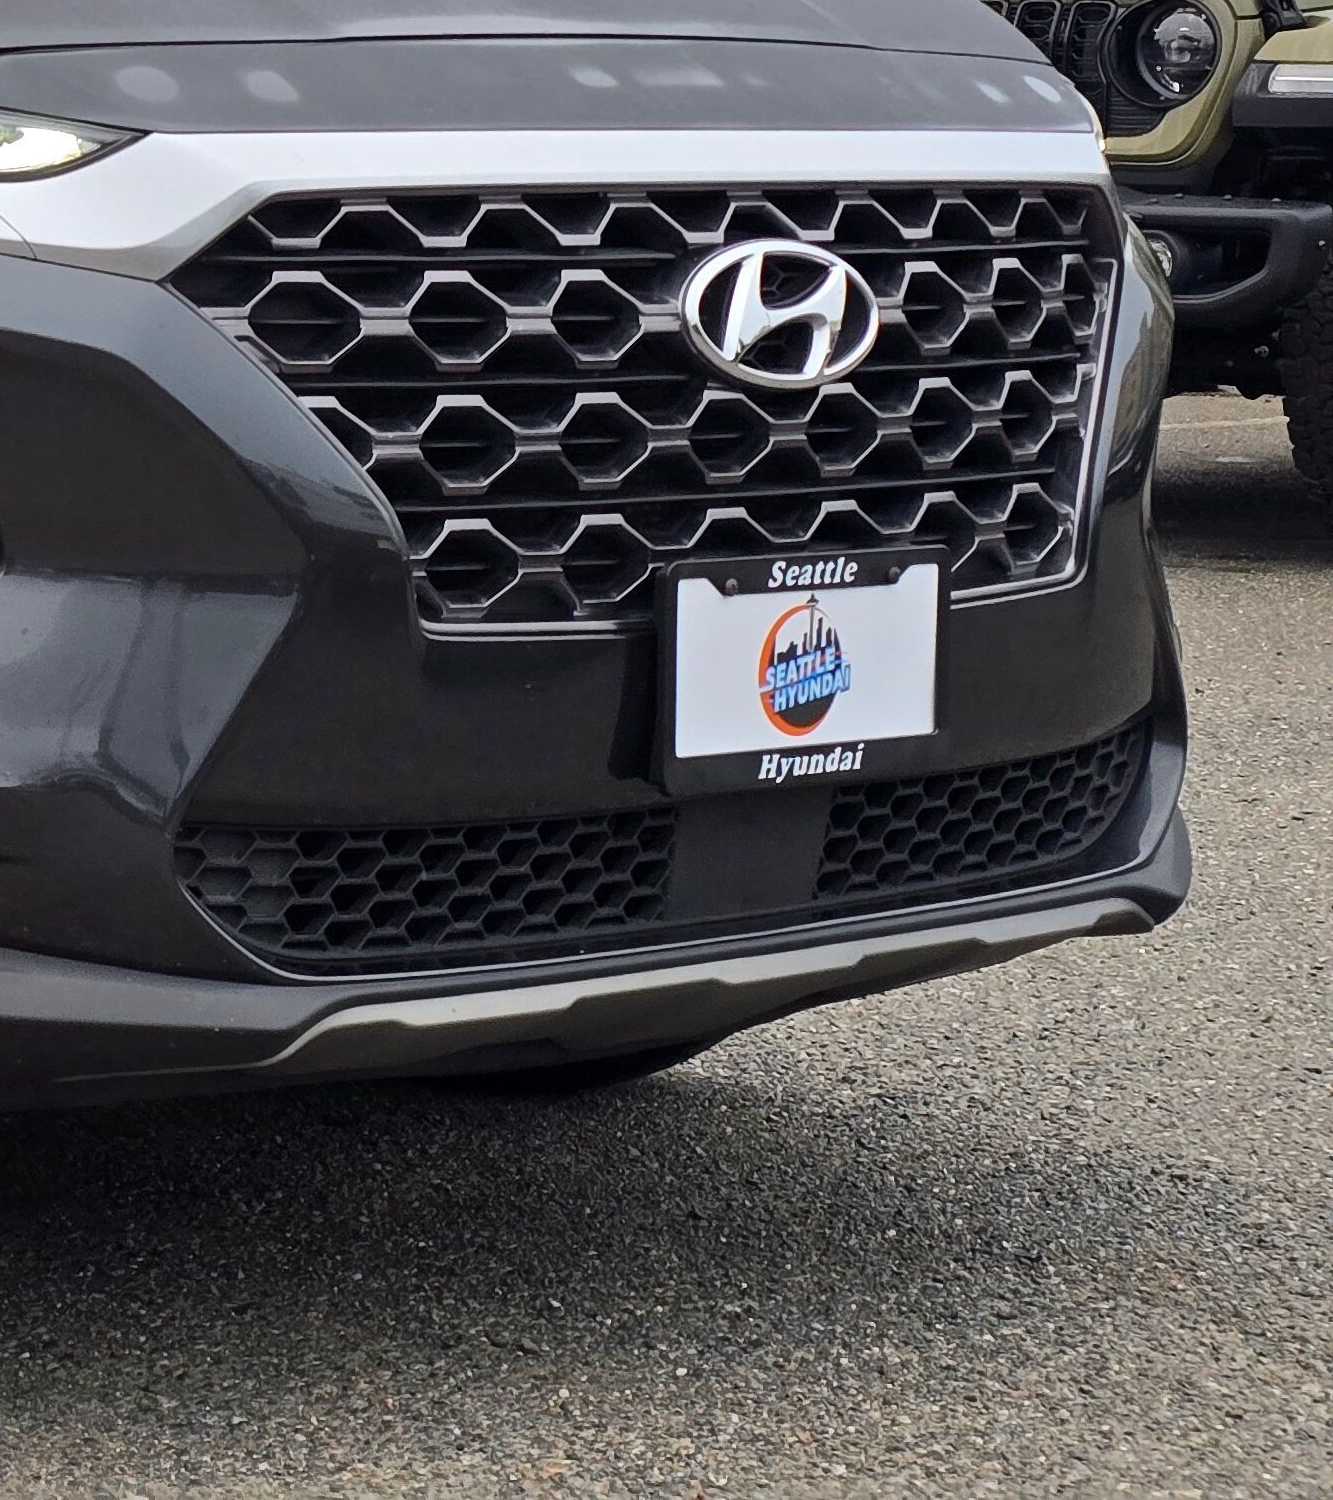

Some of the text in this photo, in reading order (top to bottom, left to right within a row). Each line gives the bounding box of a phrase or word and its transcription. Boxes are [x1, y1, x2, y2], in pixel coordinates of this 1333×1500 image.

[767, 556, 859, 589] Seattle
[764, 646, 836, 688] SEATTLE
[774, 664, 851, 712] HYUNDAI
[758, 743, 865, 783] Hyundai
